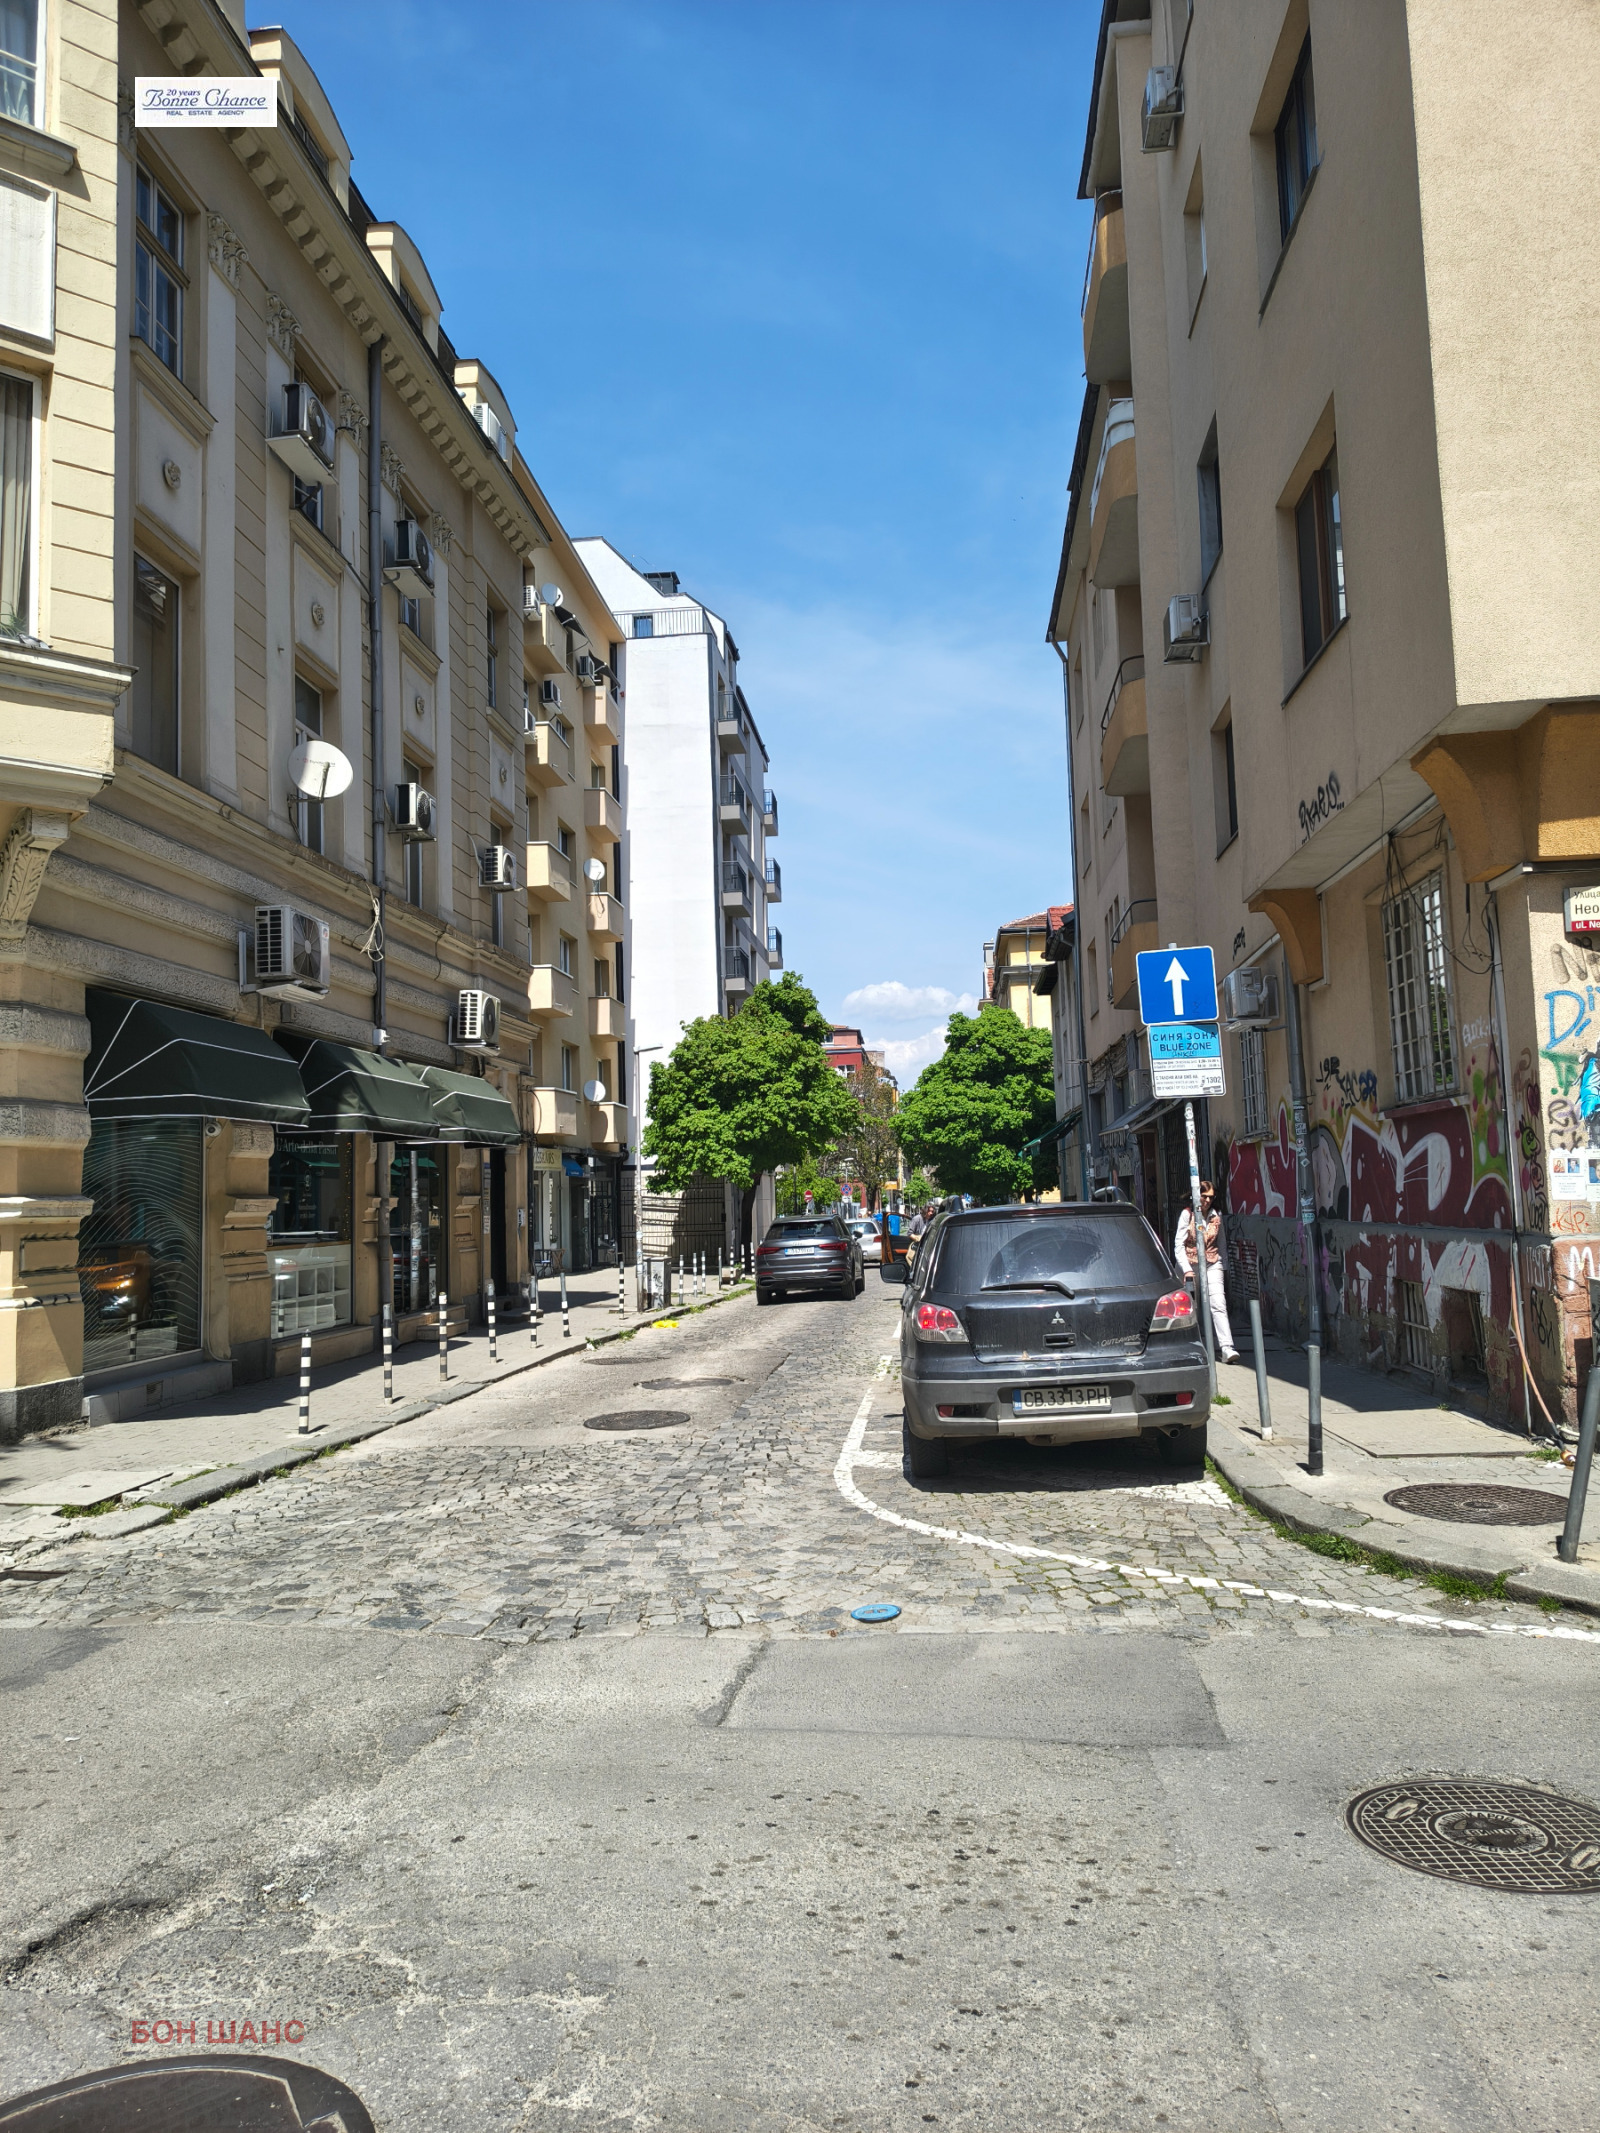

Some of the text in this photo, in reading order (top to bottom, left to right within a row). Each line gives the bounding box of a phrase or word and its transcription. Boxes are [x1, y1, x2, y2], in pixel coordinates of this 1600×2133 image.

[1152, 1031, 1217, 1042] СИНЯ ЗОНА
[1160, 1042, 1212, 1052] BLUE ZONE
[1206, 1076, 1221, 1084] 1302
[1101, 1334, 1142, 1347] OUTLANDER
